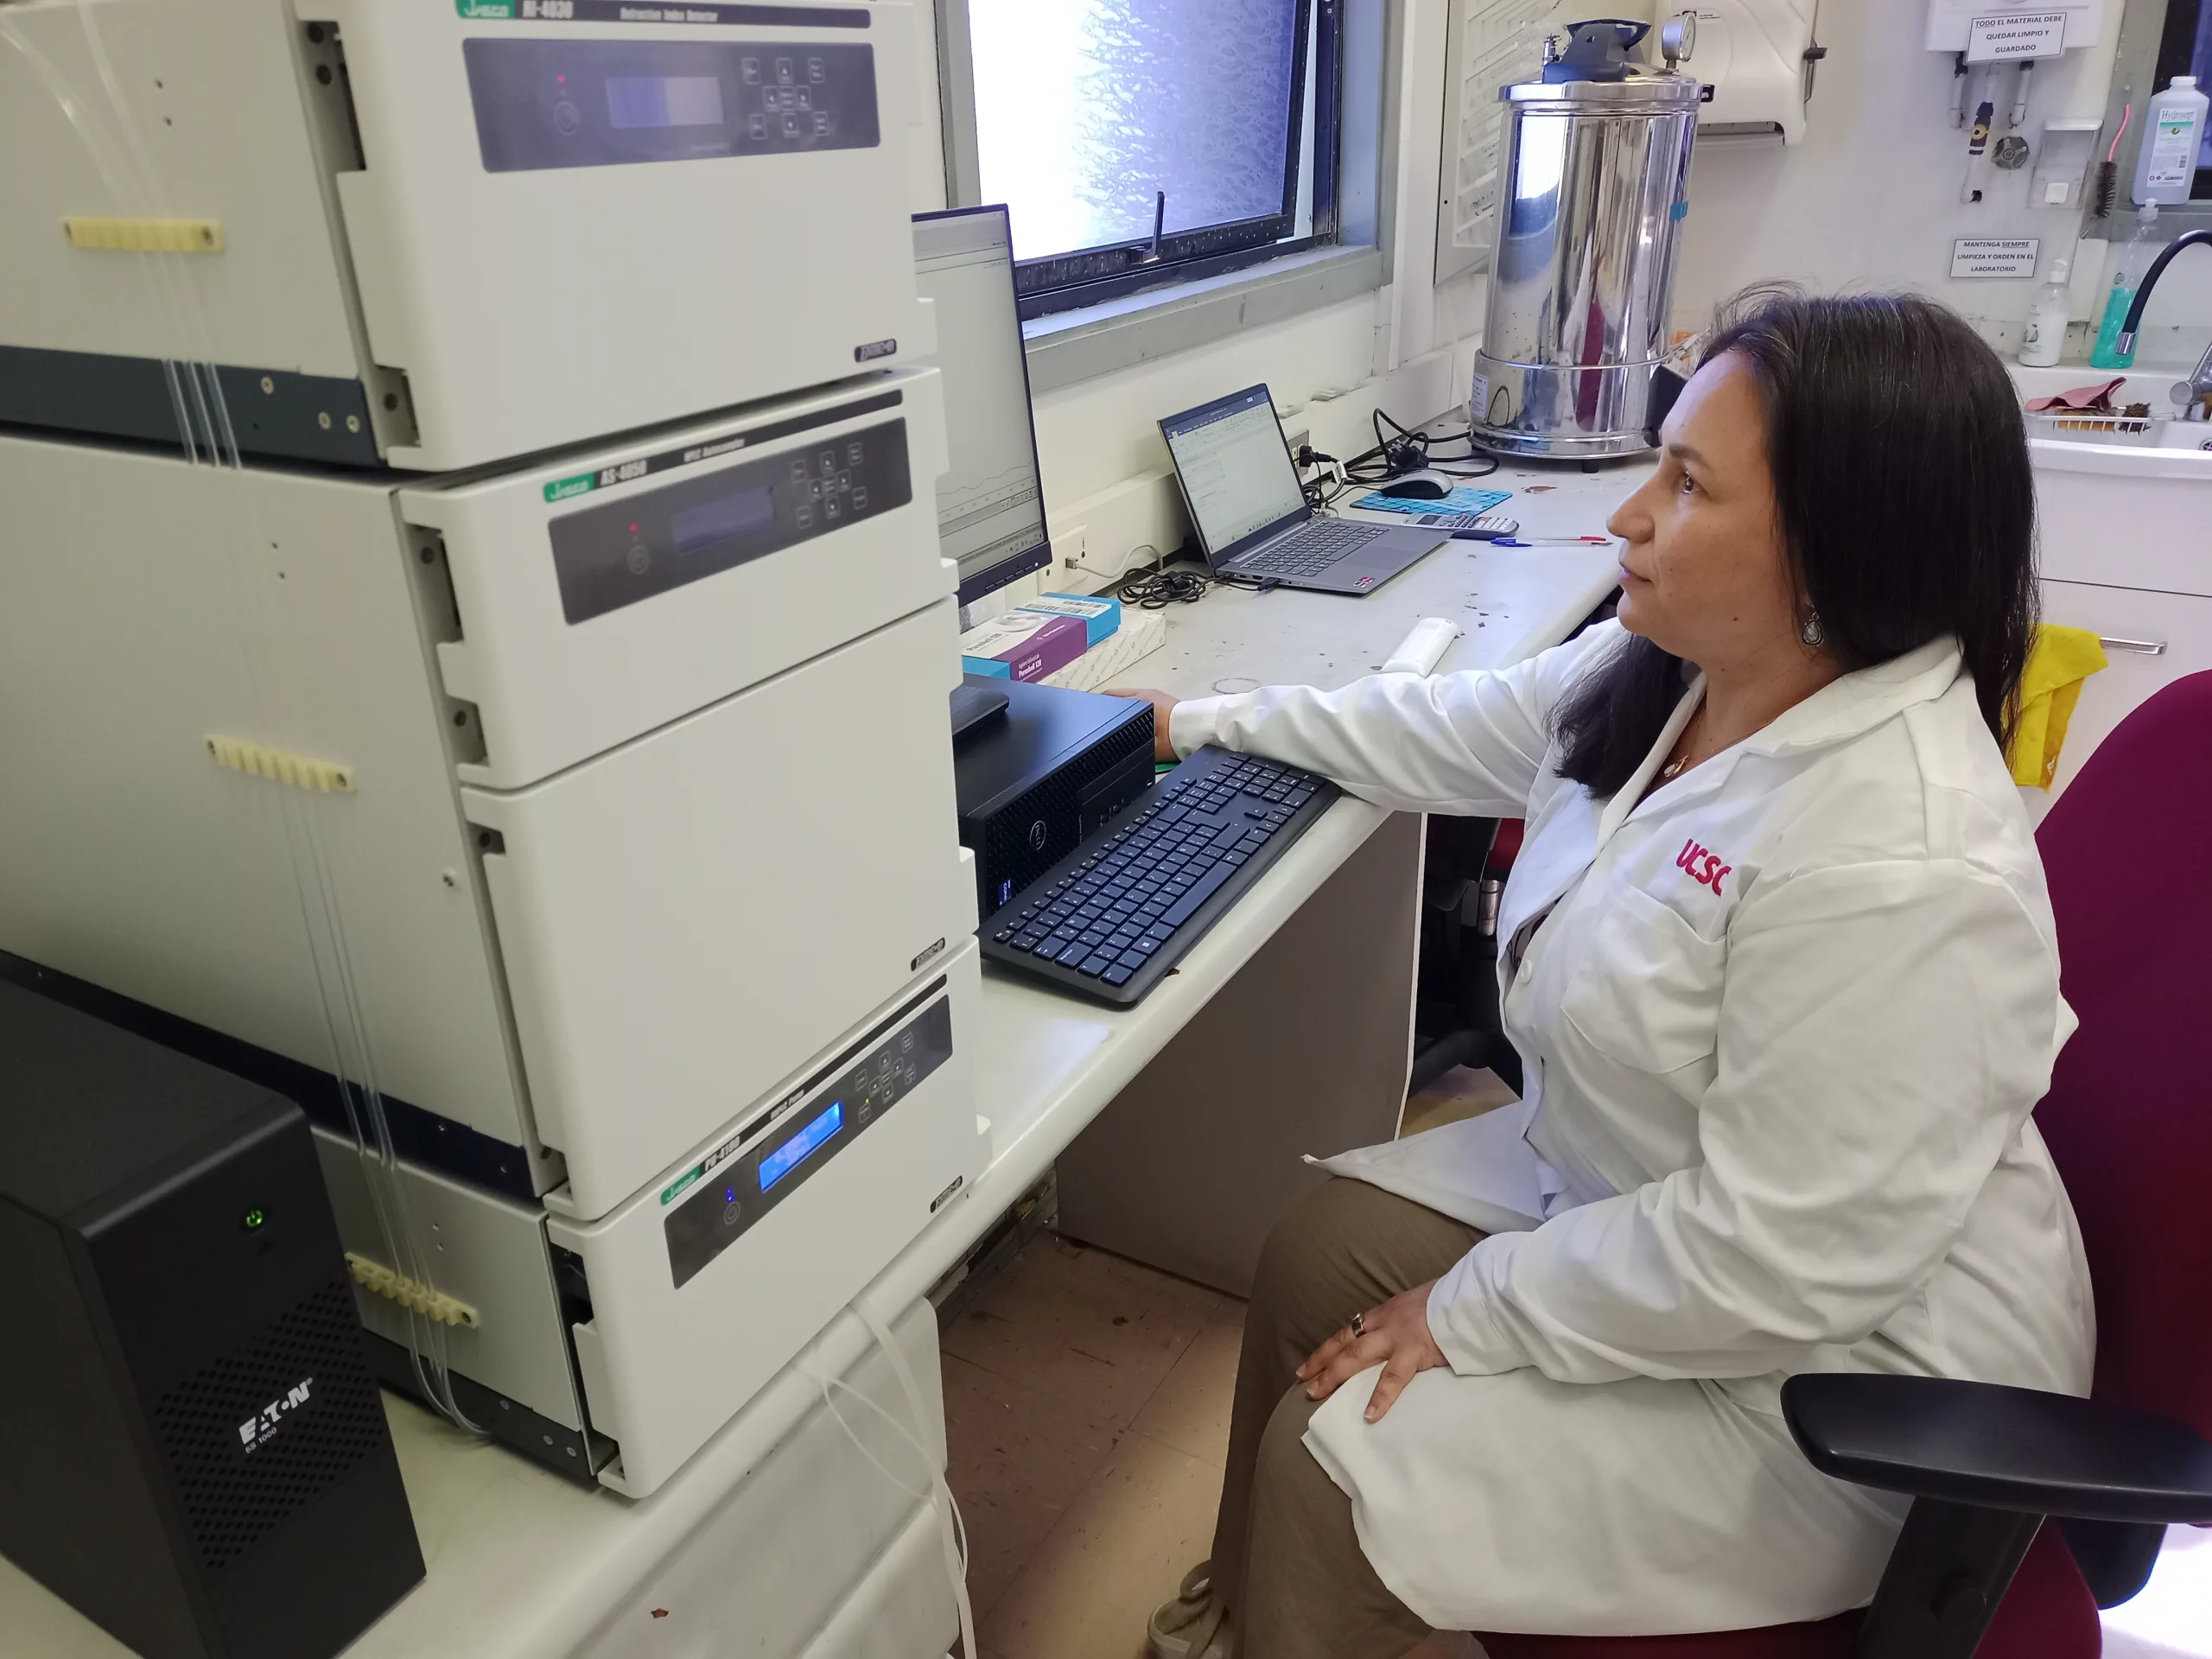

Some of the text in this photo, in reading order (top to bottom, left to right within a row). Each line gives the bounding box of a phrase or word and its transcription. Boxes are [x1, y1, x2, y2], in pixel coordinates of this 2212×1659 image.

[1995, 44, 2037, 53] GUARDADO
[1676, 838, 1732, 897] UCSC
[238, 1381, 310, 1445] EATON
[258, 1427, 277, 1444] 1000
